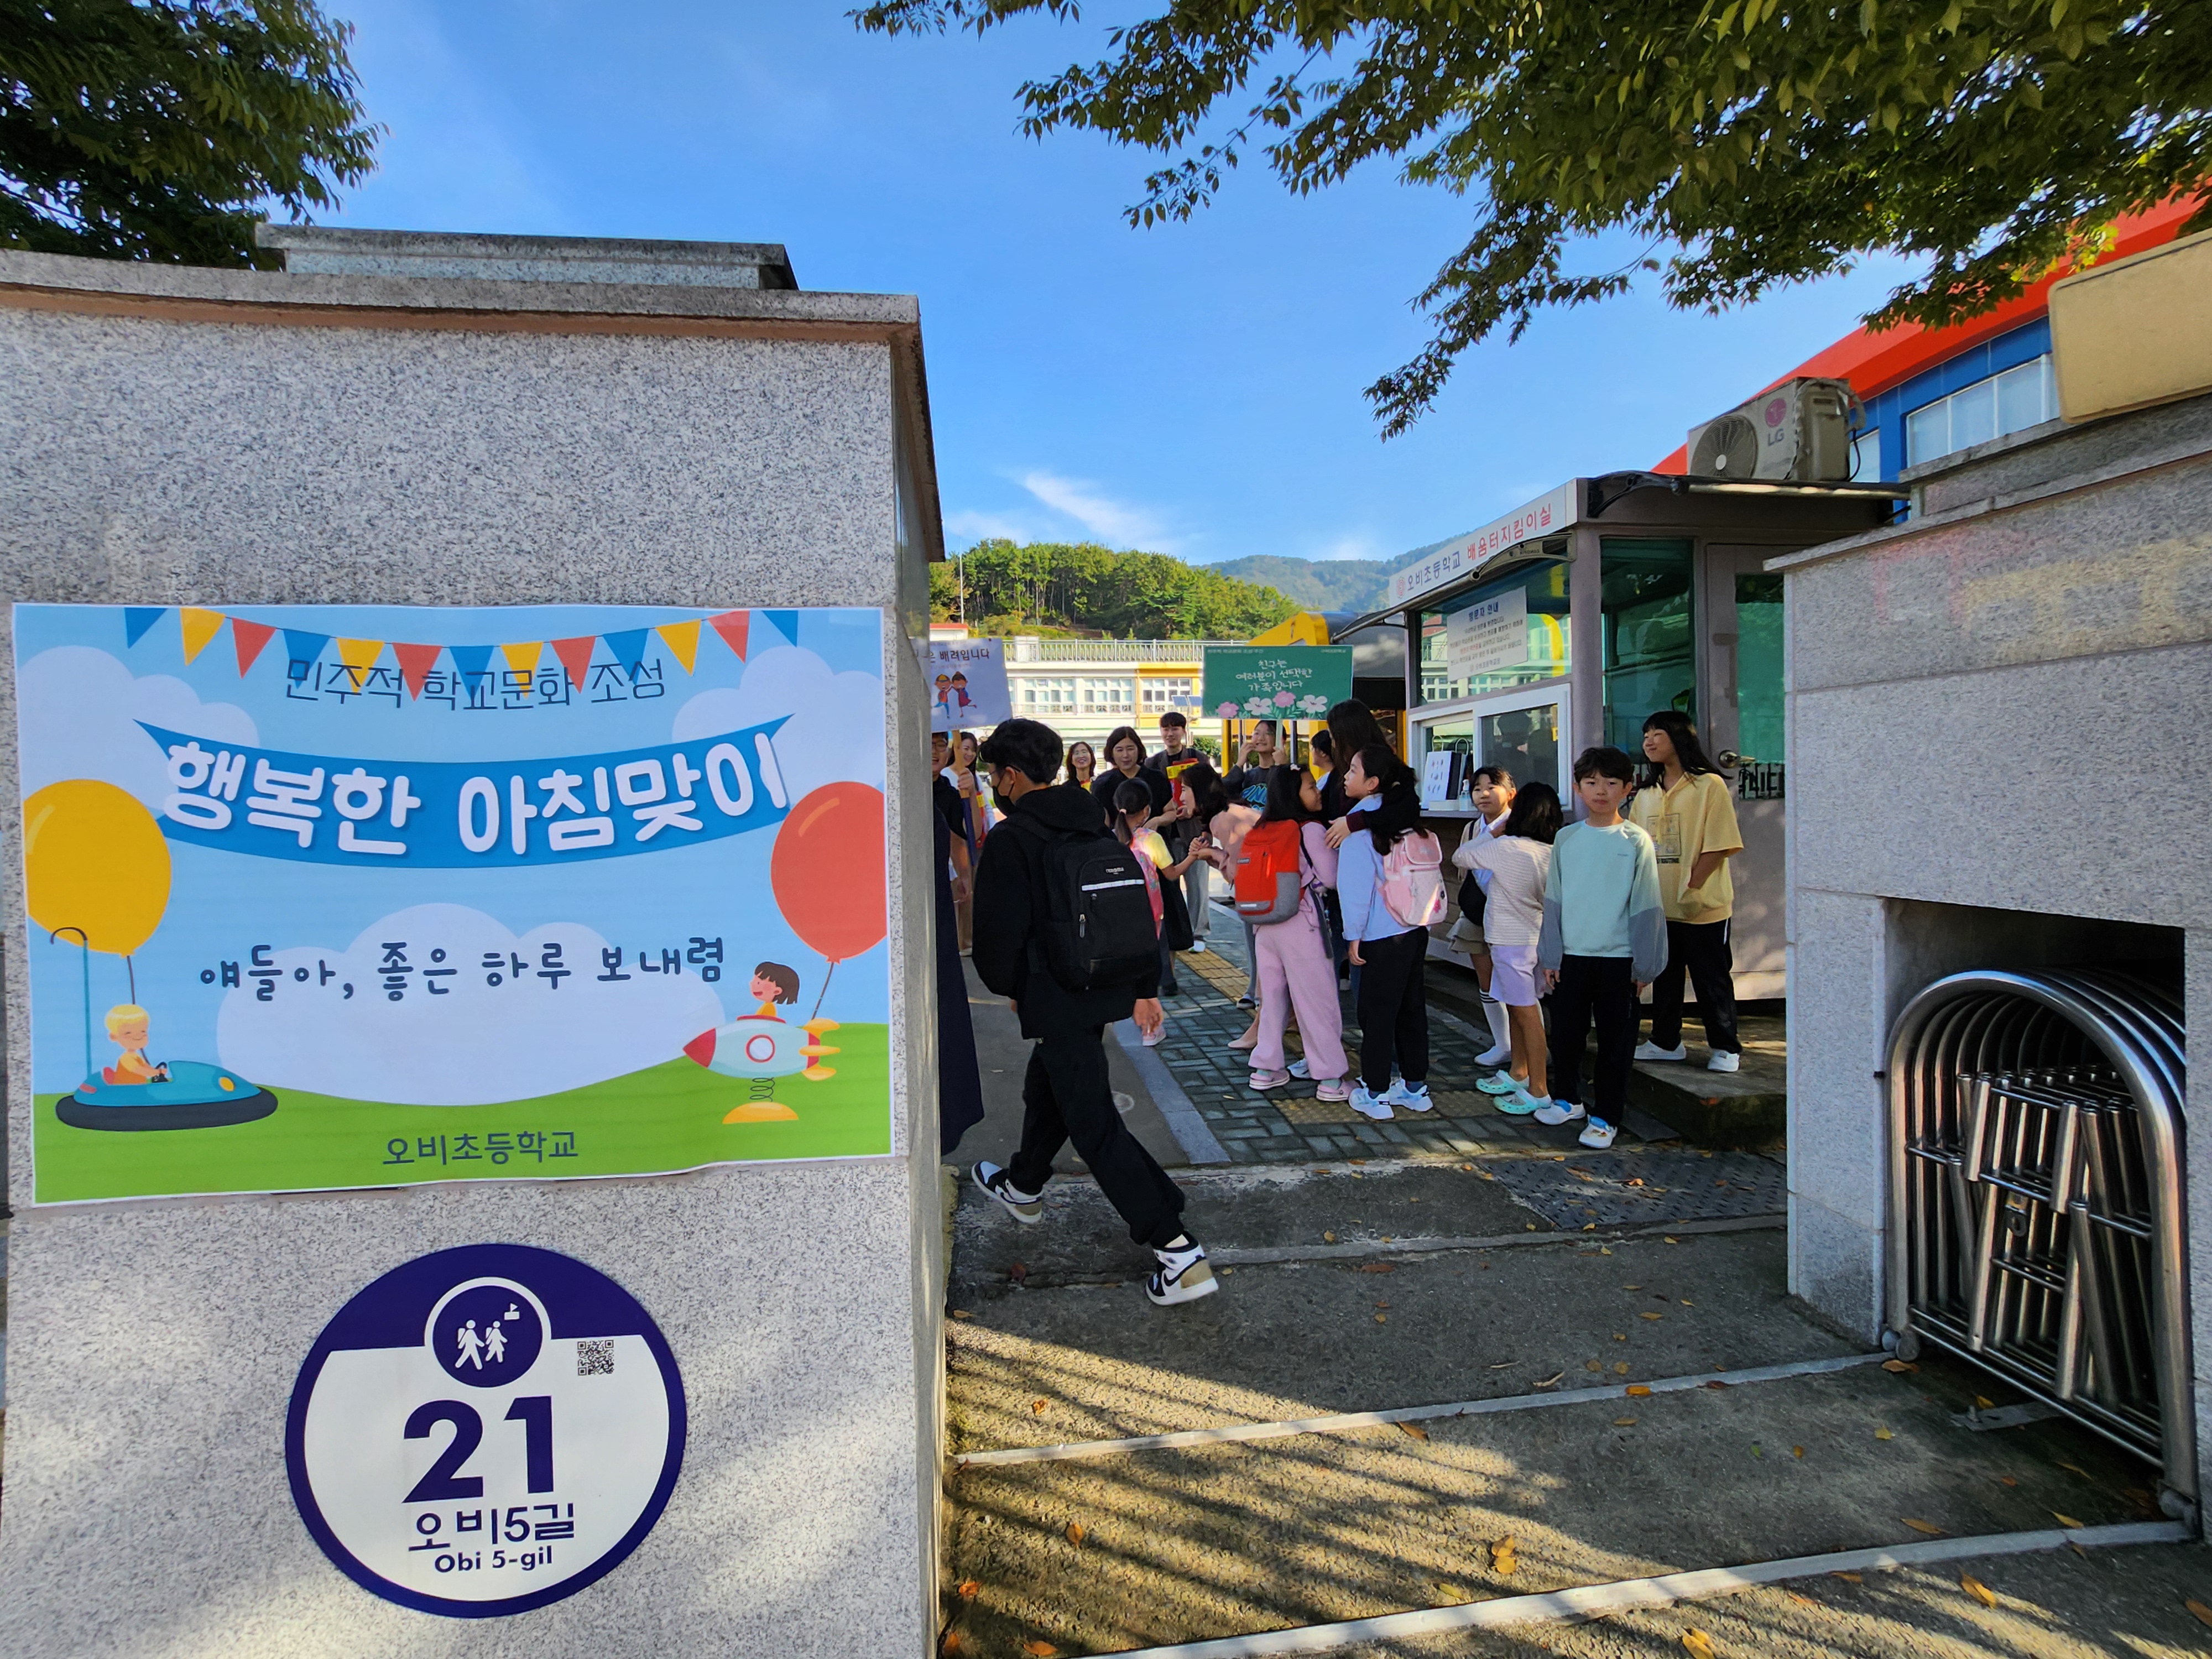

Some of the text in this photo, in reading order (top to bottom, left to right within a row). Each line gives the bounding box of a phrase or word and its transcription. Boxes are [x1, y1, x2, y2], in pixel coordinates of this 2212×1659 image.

[1767, 429, 1784, 446] LG
[1407, 503, 1551, 591] 오비초등학교 배움터지킴이실
[940, 649, 989, 661] 배려입니다
[1235, 668, 1313, 681] 여러분이 선택한
[1258, 659, 1287, 669] 친구는
[287, 659, 665, 711] 민주적 학교문화 조성
[163, 732, 788, 855] 행복한 아침맞이
[200, 936, 724, 1001] 얘들아, 좋은 하루 보내렴
[383, 1130, 578, 1165] 오비초등학교
[401, 1395, 554, 1504] 21
[409, 1503, 575, 1552] 오비5길
[434, 1545, 553, 1573] Obi 5-gil
